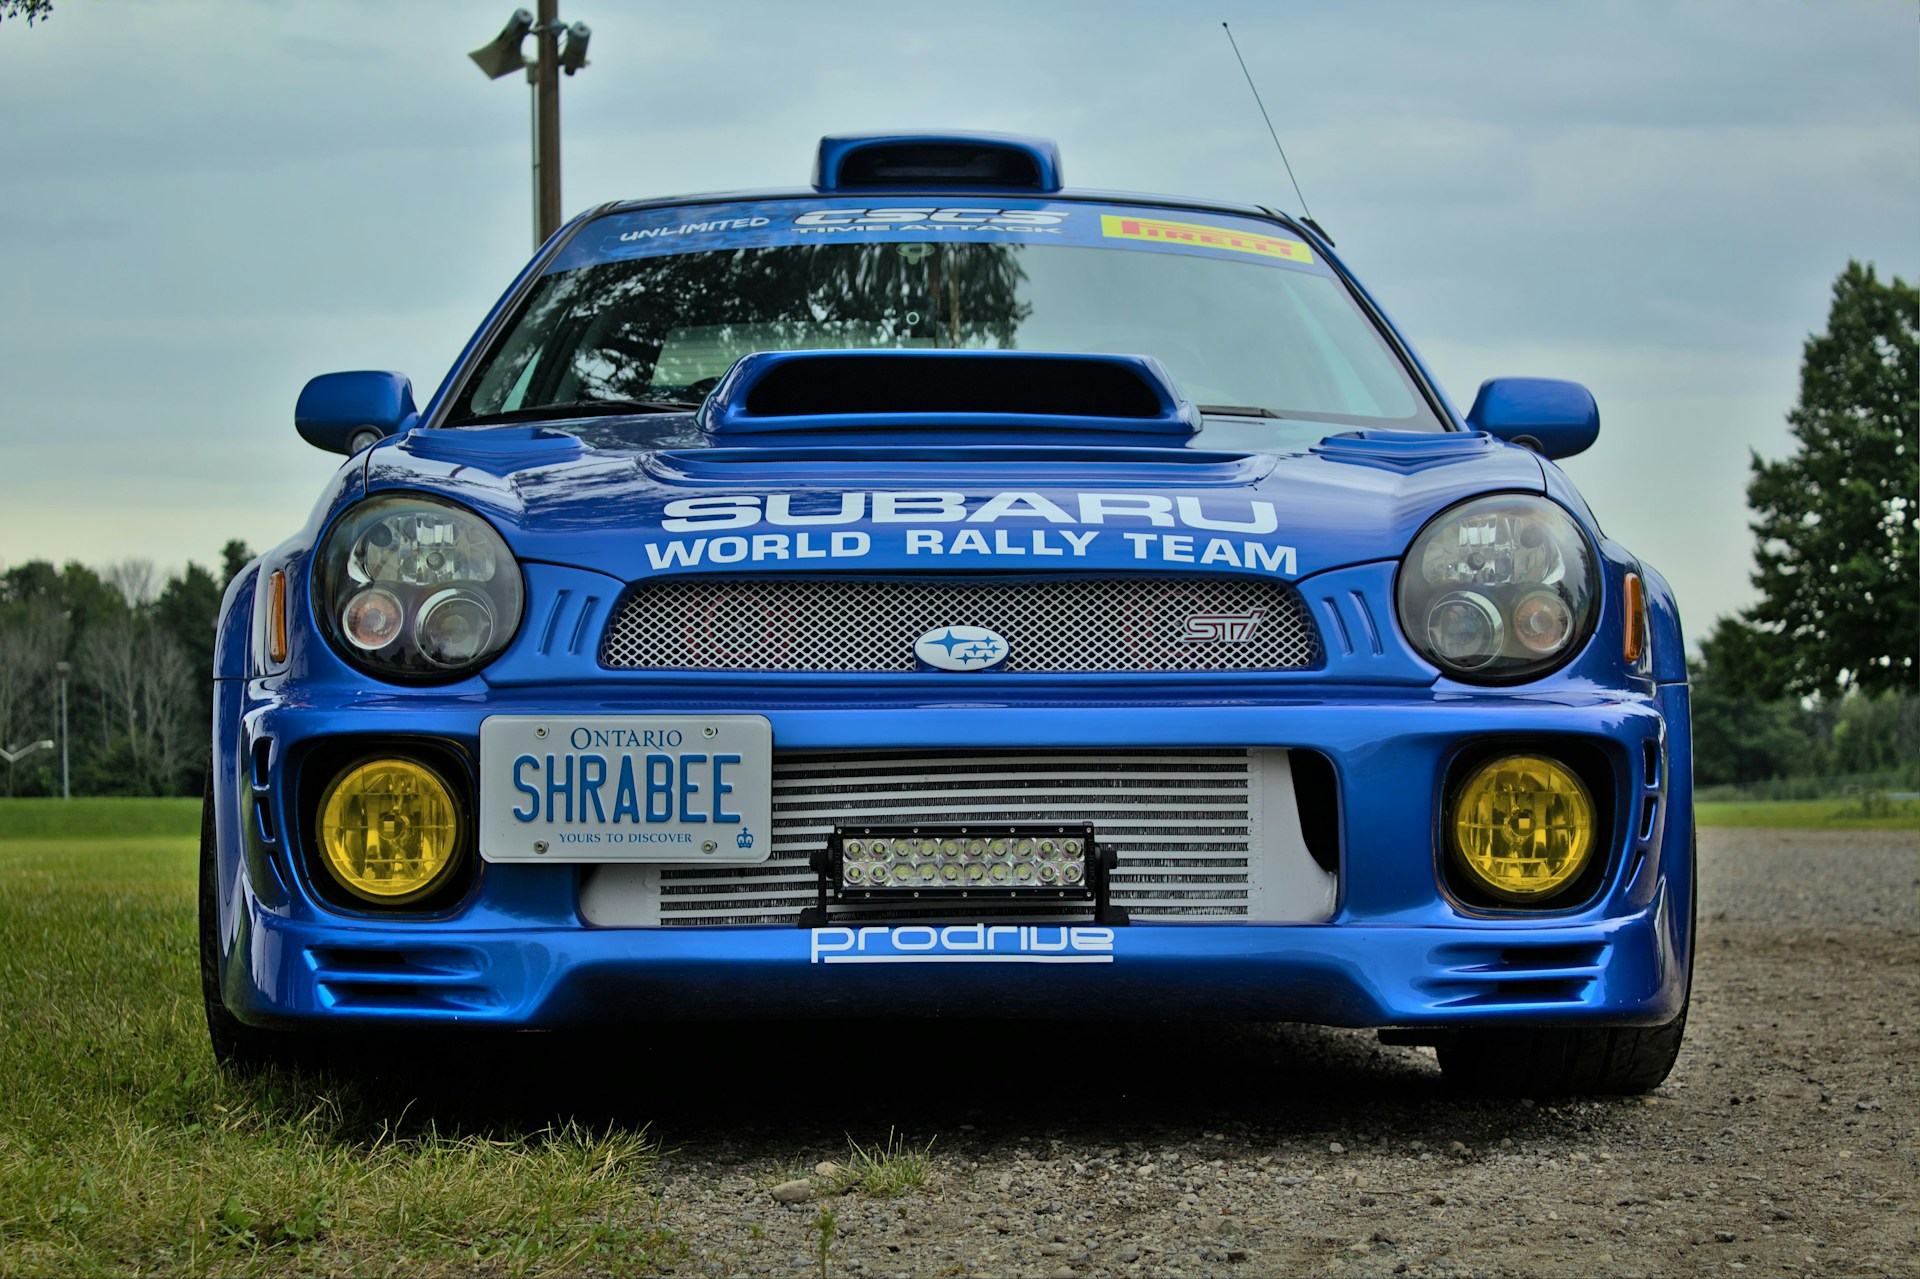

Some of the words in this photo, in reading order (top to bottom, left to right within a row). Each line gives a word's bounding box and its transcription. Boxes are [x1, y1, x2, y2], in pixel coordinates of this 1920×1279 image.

[620, 217, 770, 242] UNLIMITED
[791, 225, 891, 233] TIME
[897, 225, 1061, 233] ATTACK
[793, 207, 1070, 225] CSCS
[1121, 220, 1292, 256] PIRELLI
[661, 491, 1278, 535] SUBARU
[645, 531, 871, 570] WORLD
[906, 529, 1100, 557] RALLY
[1124, 532, 1297, 575] TEAM
[513, 754, 741, 823] SHRABEE
[559, 832, 601, 844] YOURS
[607, 833, 624, 843] TO
[628, 832, 693, 844] DISCOVER
[811, 923, 1115, 964] prodrive
